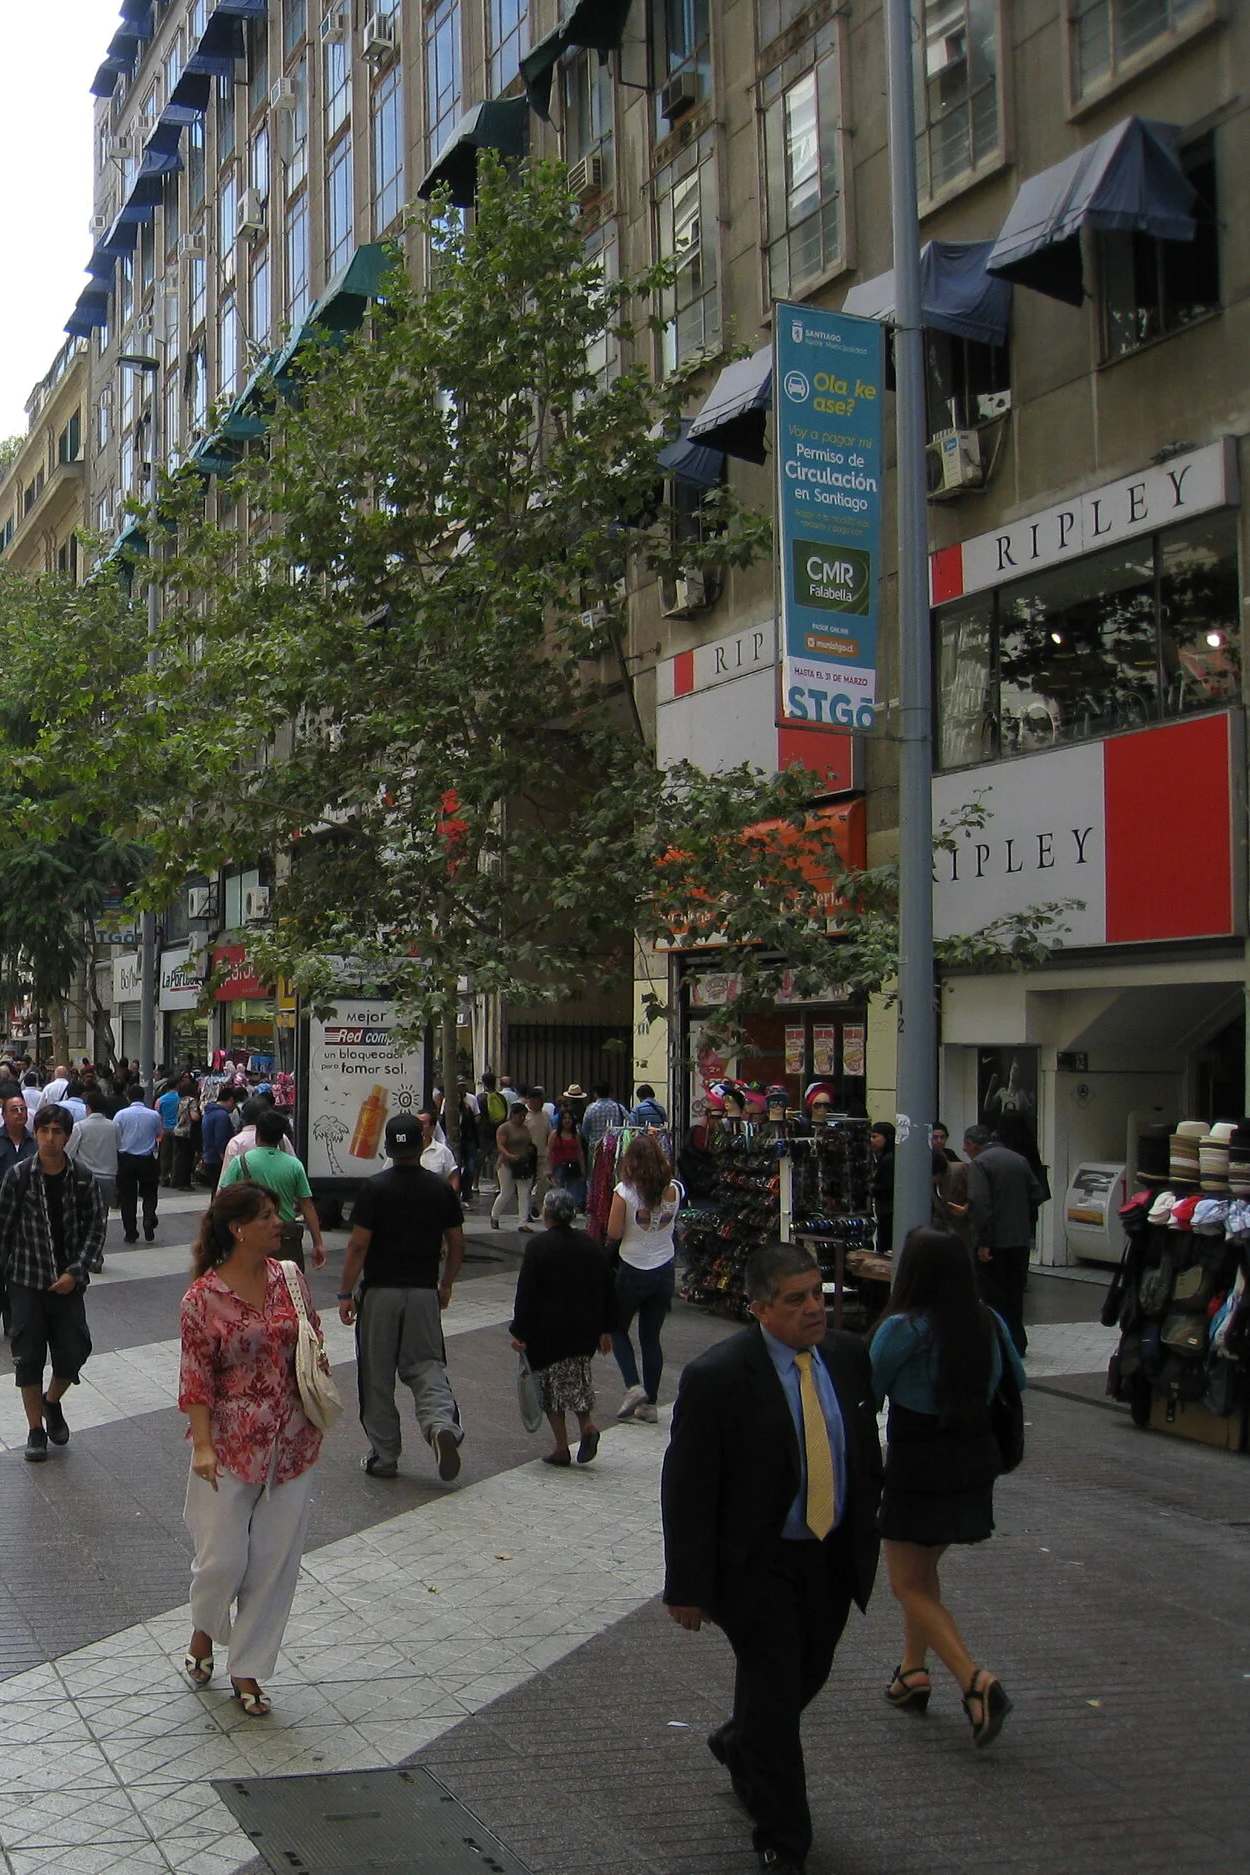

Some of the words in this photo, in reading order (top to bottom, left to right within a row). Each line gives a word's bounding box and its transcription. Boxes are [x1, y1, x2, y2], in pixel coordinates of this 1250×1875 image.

[805, 329, 841, 342] SANTIAGO
[813, 372, 848, 395] Ola
[854, 379, 877, 399] ke
[813, 396, 855, 416] ase?
[789, 424, 807, 440] Voy
[810, 430, 818, 440] a
[822, 432, 855, 447] pagar
[858, 437, 872, 449] mi
[796, 443, 844, 464] Permiso
[848, 453, 864, 467] de
[785, 460, 878, 492] Circulación
[795, 488, 810, 500] en
[814, 488, 868, 512] Santiago
[996, 464, 1192, 572] RIPLEY
[806, 556, 854, 588] CMR
[809, 583, 852, 603] Falabella
[794, 667, 815, 678] HASTA
[816, 671, 824, 679] EL
[832, 673, 842, 683] DE
[843, 676, 868, 687] MARZO
[347, 1010, 387, 1025] Mejor
[338, 1029, 363, 1043] Red
[341, 1062, 381, 1075] tomar
[384, 1063, 407, 1075] sol.
